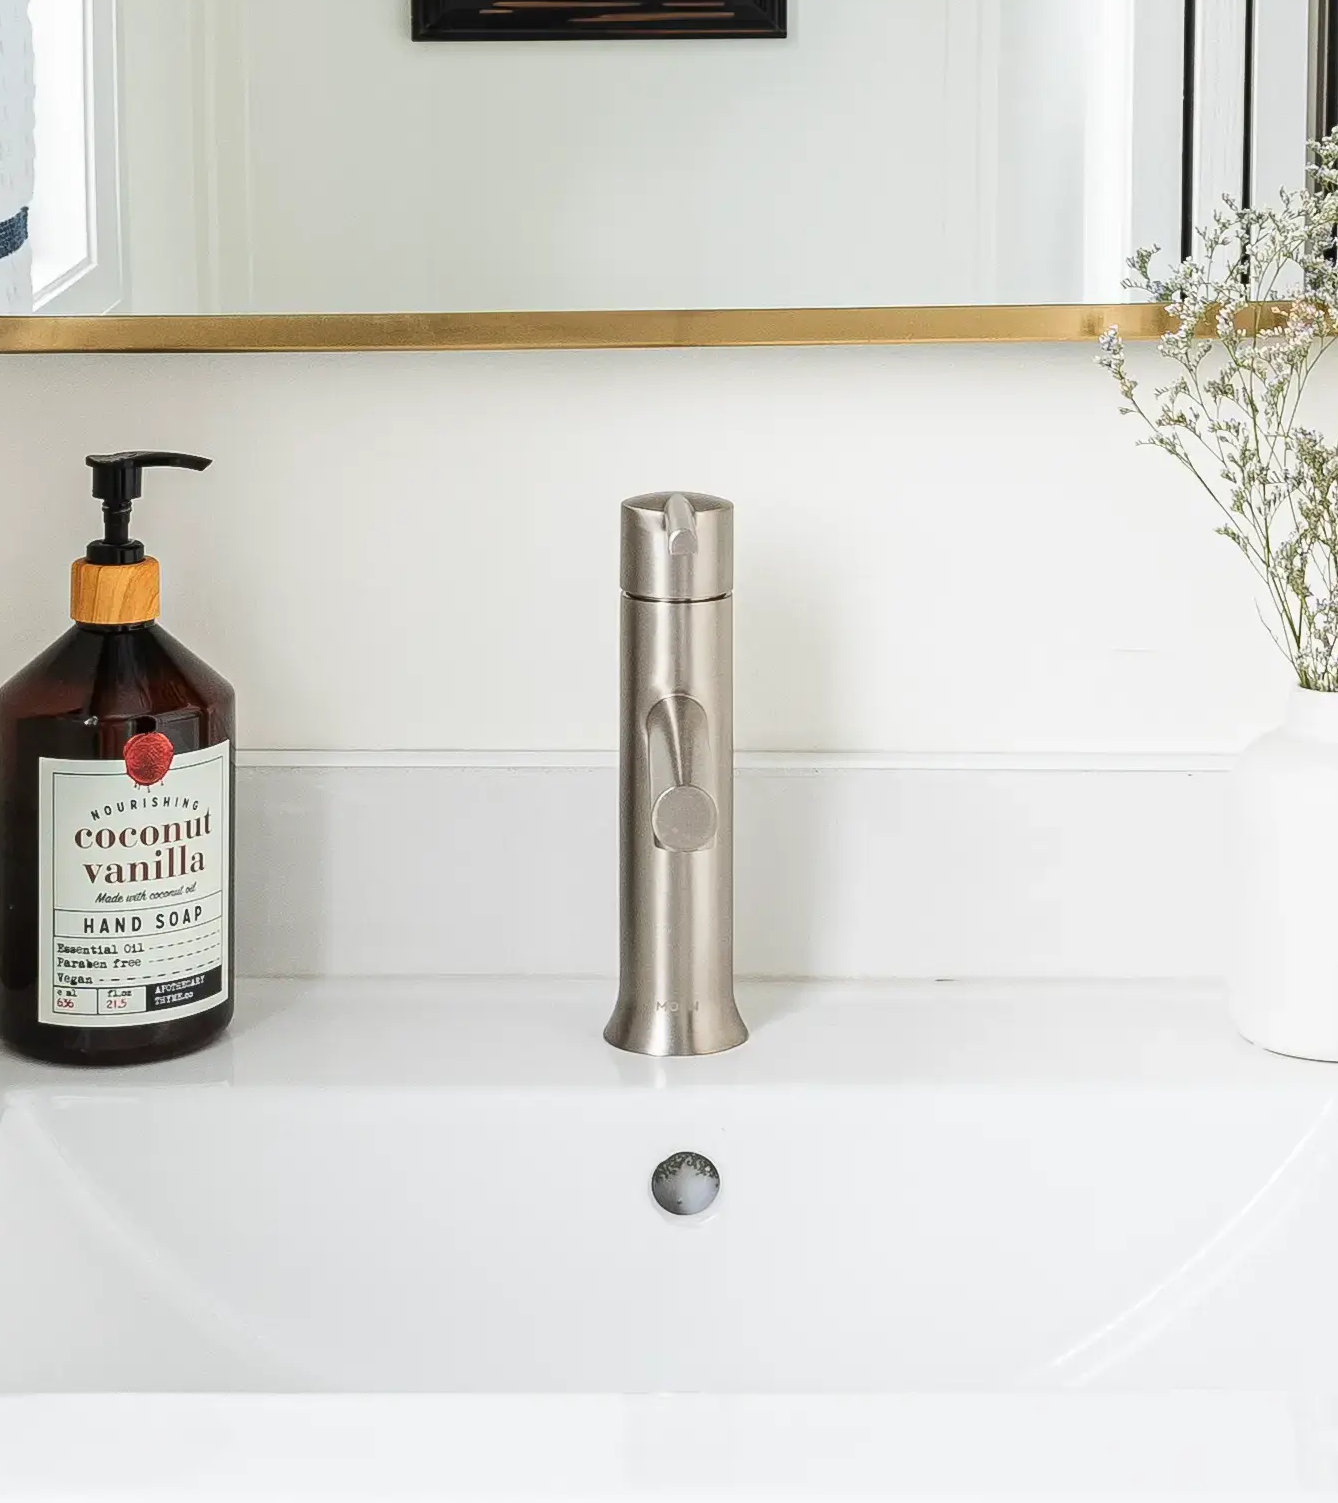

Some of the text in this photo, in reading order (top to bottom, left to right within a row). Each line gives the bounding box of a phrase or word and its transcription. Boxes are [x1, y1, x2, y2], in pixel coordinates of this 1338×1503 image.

[90, 796, 200, 821] NOURISHING
[74, 807, 212, 849] coconut
[82, 844, 206, 884] vanilla
[95, 881, 198, 904] Made with coconut oil
[83, 905, 203, 934] HAND SOAP
[57, 943, 145, 955] Essential Oil
[57, 957, 142, 969] Paraben free
[57, 973, 93, 985] Vegan
[154, 974, 206, 995] APOTHECARY
[56, 998, 74, 1009] 636
[106, 1000, 128, 1009] 21.5
